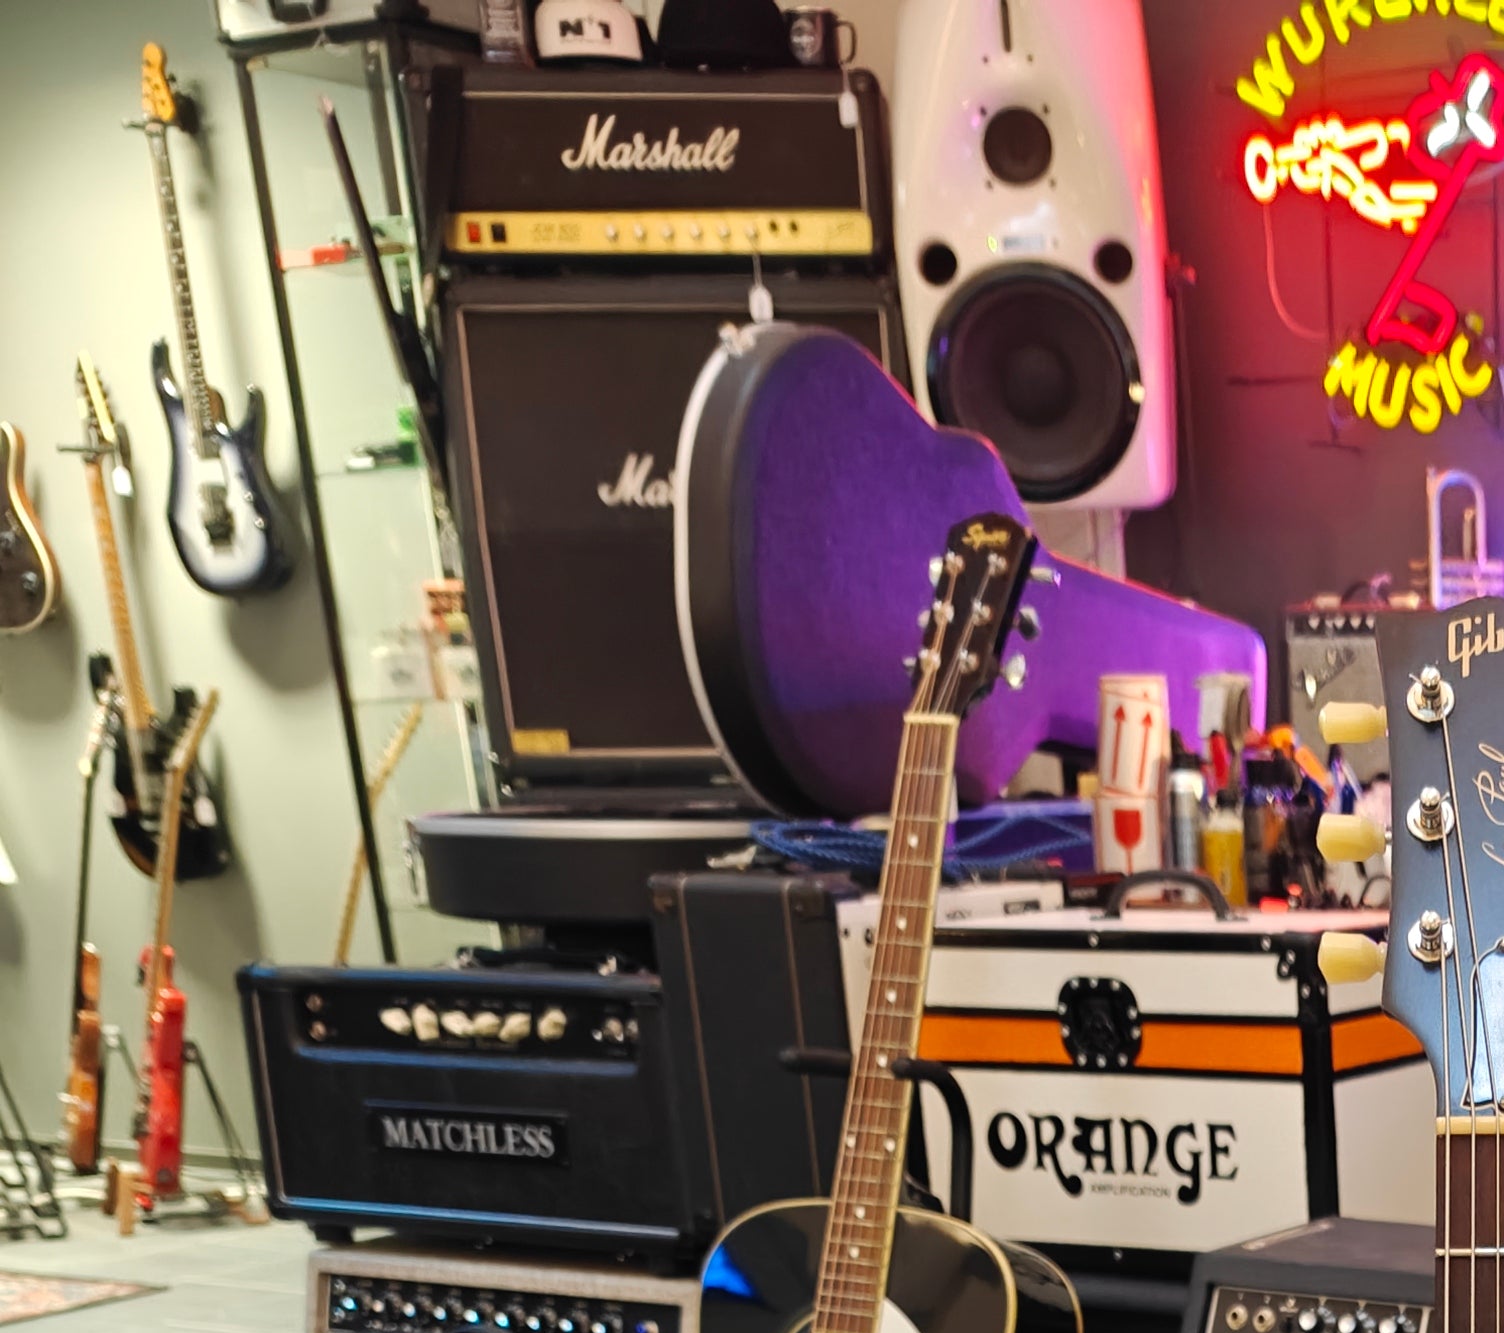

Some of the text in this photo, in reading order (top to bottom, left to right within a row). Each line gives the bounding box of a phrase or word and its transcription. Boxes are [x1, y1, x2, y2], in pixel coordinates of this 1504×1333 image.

[560, 113, 740, 171] Marshall
[1324, 333, 1493, 434] MUSIC
[381, 1114, 555, 1159] MATCHLESS
[987, 1111, 1239, 1206] ORANGE
